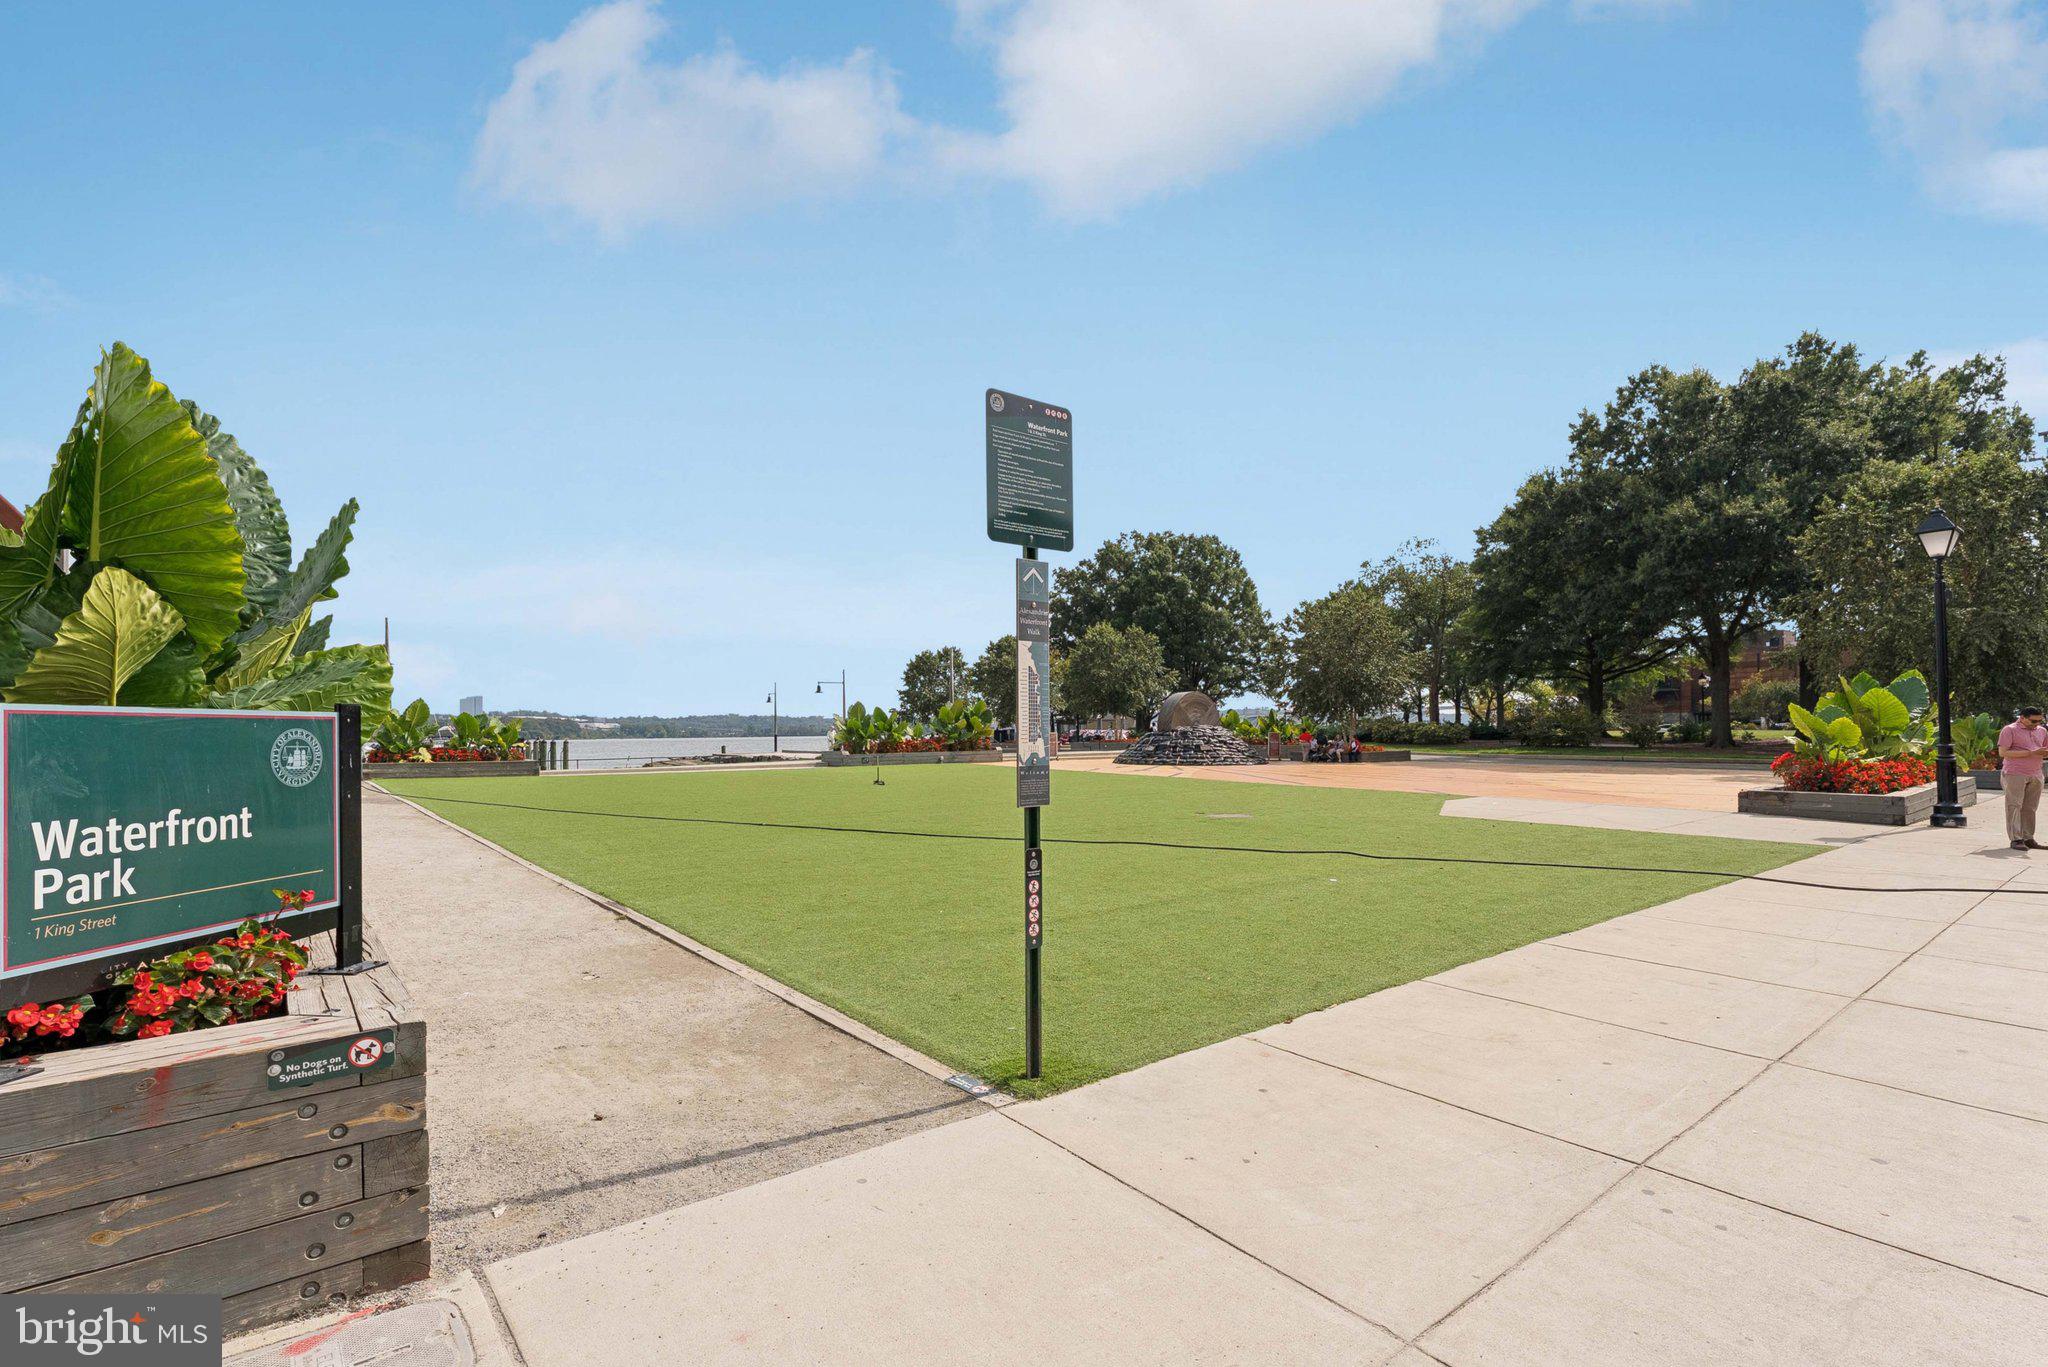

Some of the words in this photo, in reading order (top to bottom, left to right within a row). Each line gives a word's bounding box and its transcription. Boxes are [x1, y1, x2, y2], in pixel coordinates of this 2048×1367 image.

[1027, 422, 1056, 435] Waterfront
[1056, 429, 1069, 437] Park
[277, 769, 317, 785] VIRGINIA
[31, 806, 253, 862] Waterfront
[33, 858, 137, 911] Park
[34, 926, 41, 940] 1
[44, 922, 75, 938] King
[78, 914, 117, 932] Street
[279, 1066, 326, 1083] Synthetic
[327, 1061, 349, 1074] Turf.
[286, 1064, 300, 1073] No
[302, 1058, 328, 1070] Dogs
[329, 1056, 342, 1064] on
